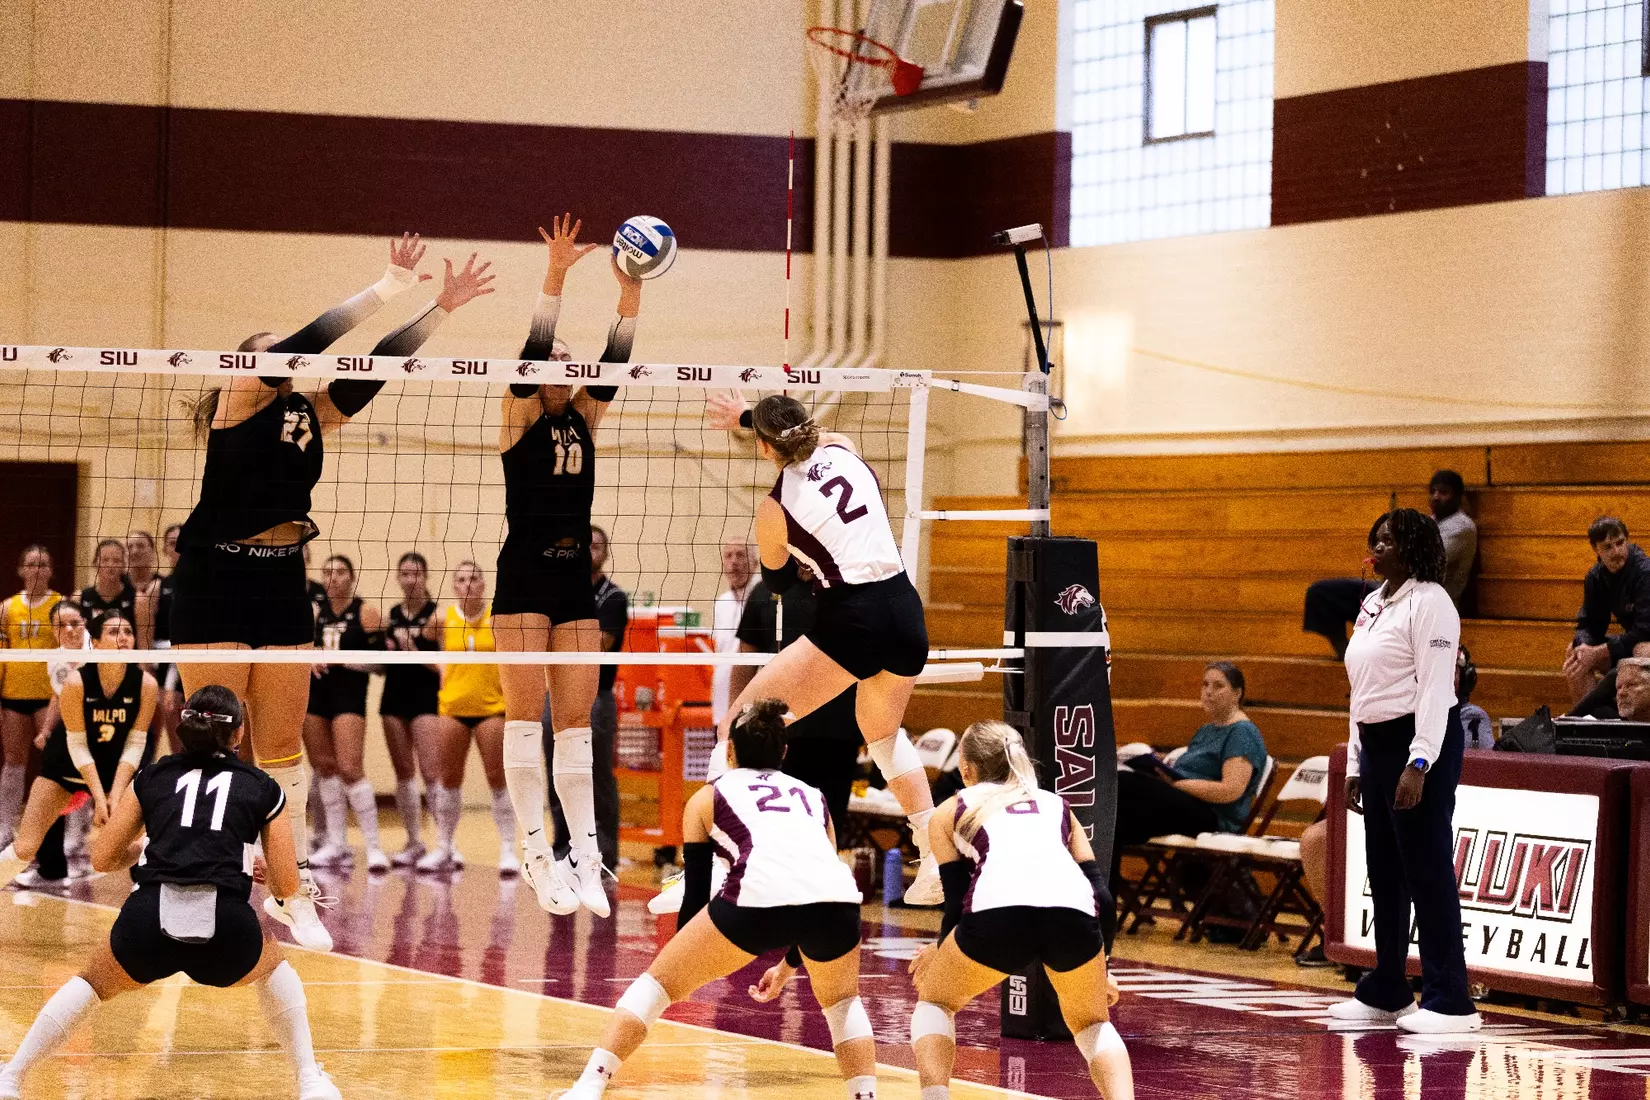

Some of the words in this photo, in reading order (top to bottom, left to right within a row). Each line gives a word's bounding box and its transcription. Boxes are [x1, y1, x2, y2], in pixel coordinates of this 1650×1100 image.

[616, 236, 643, 259] molten
[100, 350, 138, 366] SIU
[219, 354, 256, 370] SIU
[336, 357, 374, 372] SIU
[451, 360, 488, 375] SIU
[565, 364, 601, 379] SIU
[677, 366, 712, 381] SIU
[787, 370, 821, 384] SIU
[553, 442, 583, 475] 10
[818, 475, 869, 524] 2
[248, 546, 287, 558] NIKE
[93, 708, 127, 724] VALPO
[175, 768, 234, 831] 11
[748, 785, 814, 817] 21
